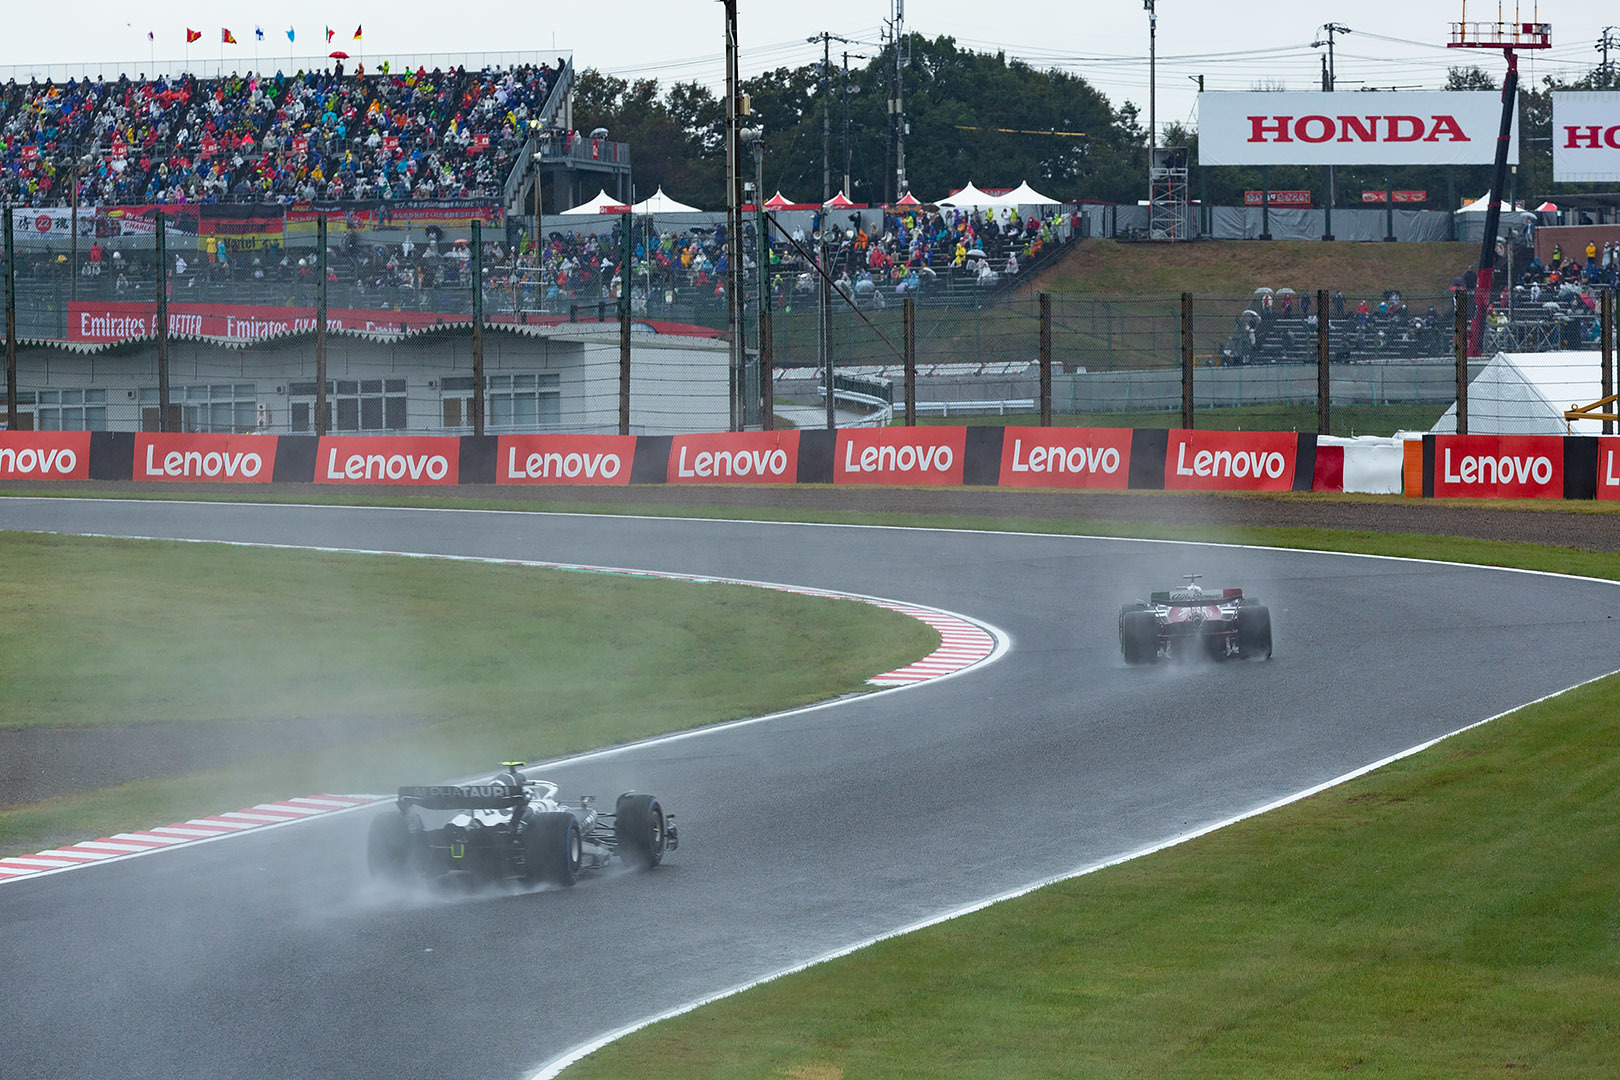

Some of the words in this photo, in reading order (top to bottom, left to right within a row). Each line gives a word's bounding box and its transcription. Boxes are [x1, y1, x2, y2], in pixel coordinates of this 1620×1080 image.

[1246, 115, 1471, 143] HONDA
[80, 312, 146, 338] Emirates
[146, 444, 263, 478] Lenovo
[327, 447, 449, 480] Lenovo
[508, 446, 621, 479] Lenovo
[678, 445, 788, 478] Lenovo
[845, 440, 954, 473] Lenovo
[1011, 439, 1120, 474] Lenovo
[1176, 442, 1285, 479] Lenovo
[1444, 448, 1553, 485] Lenovo
